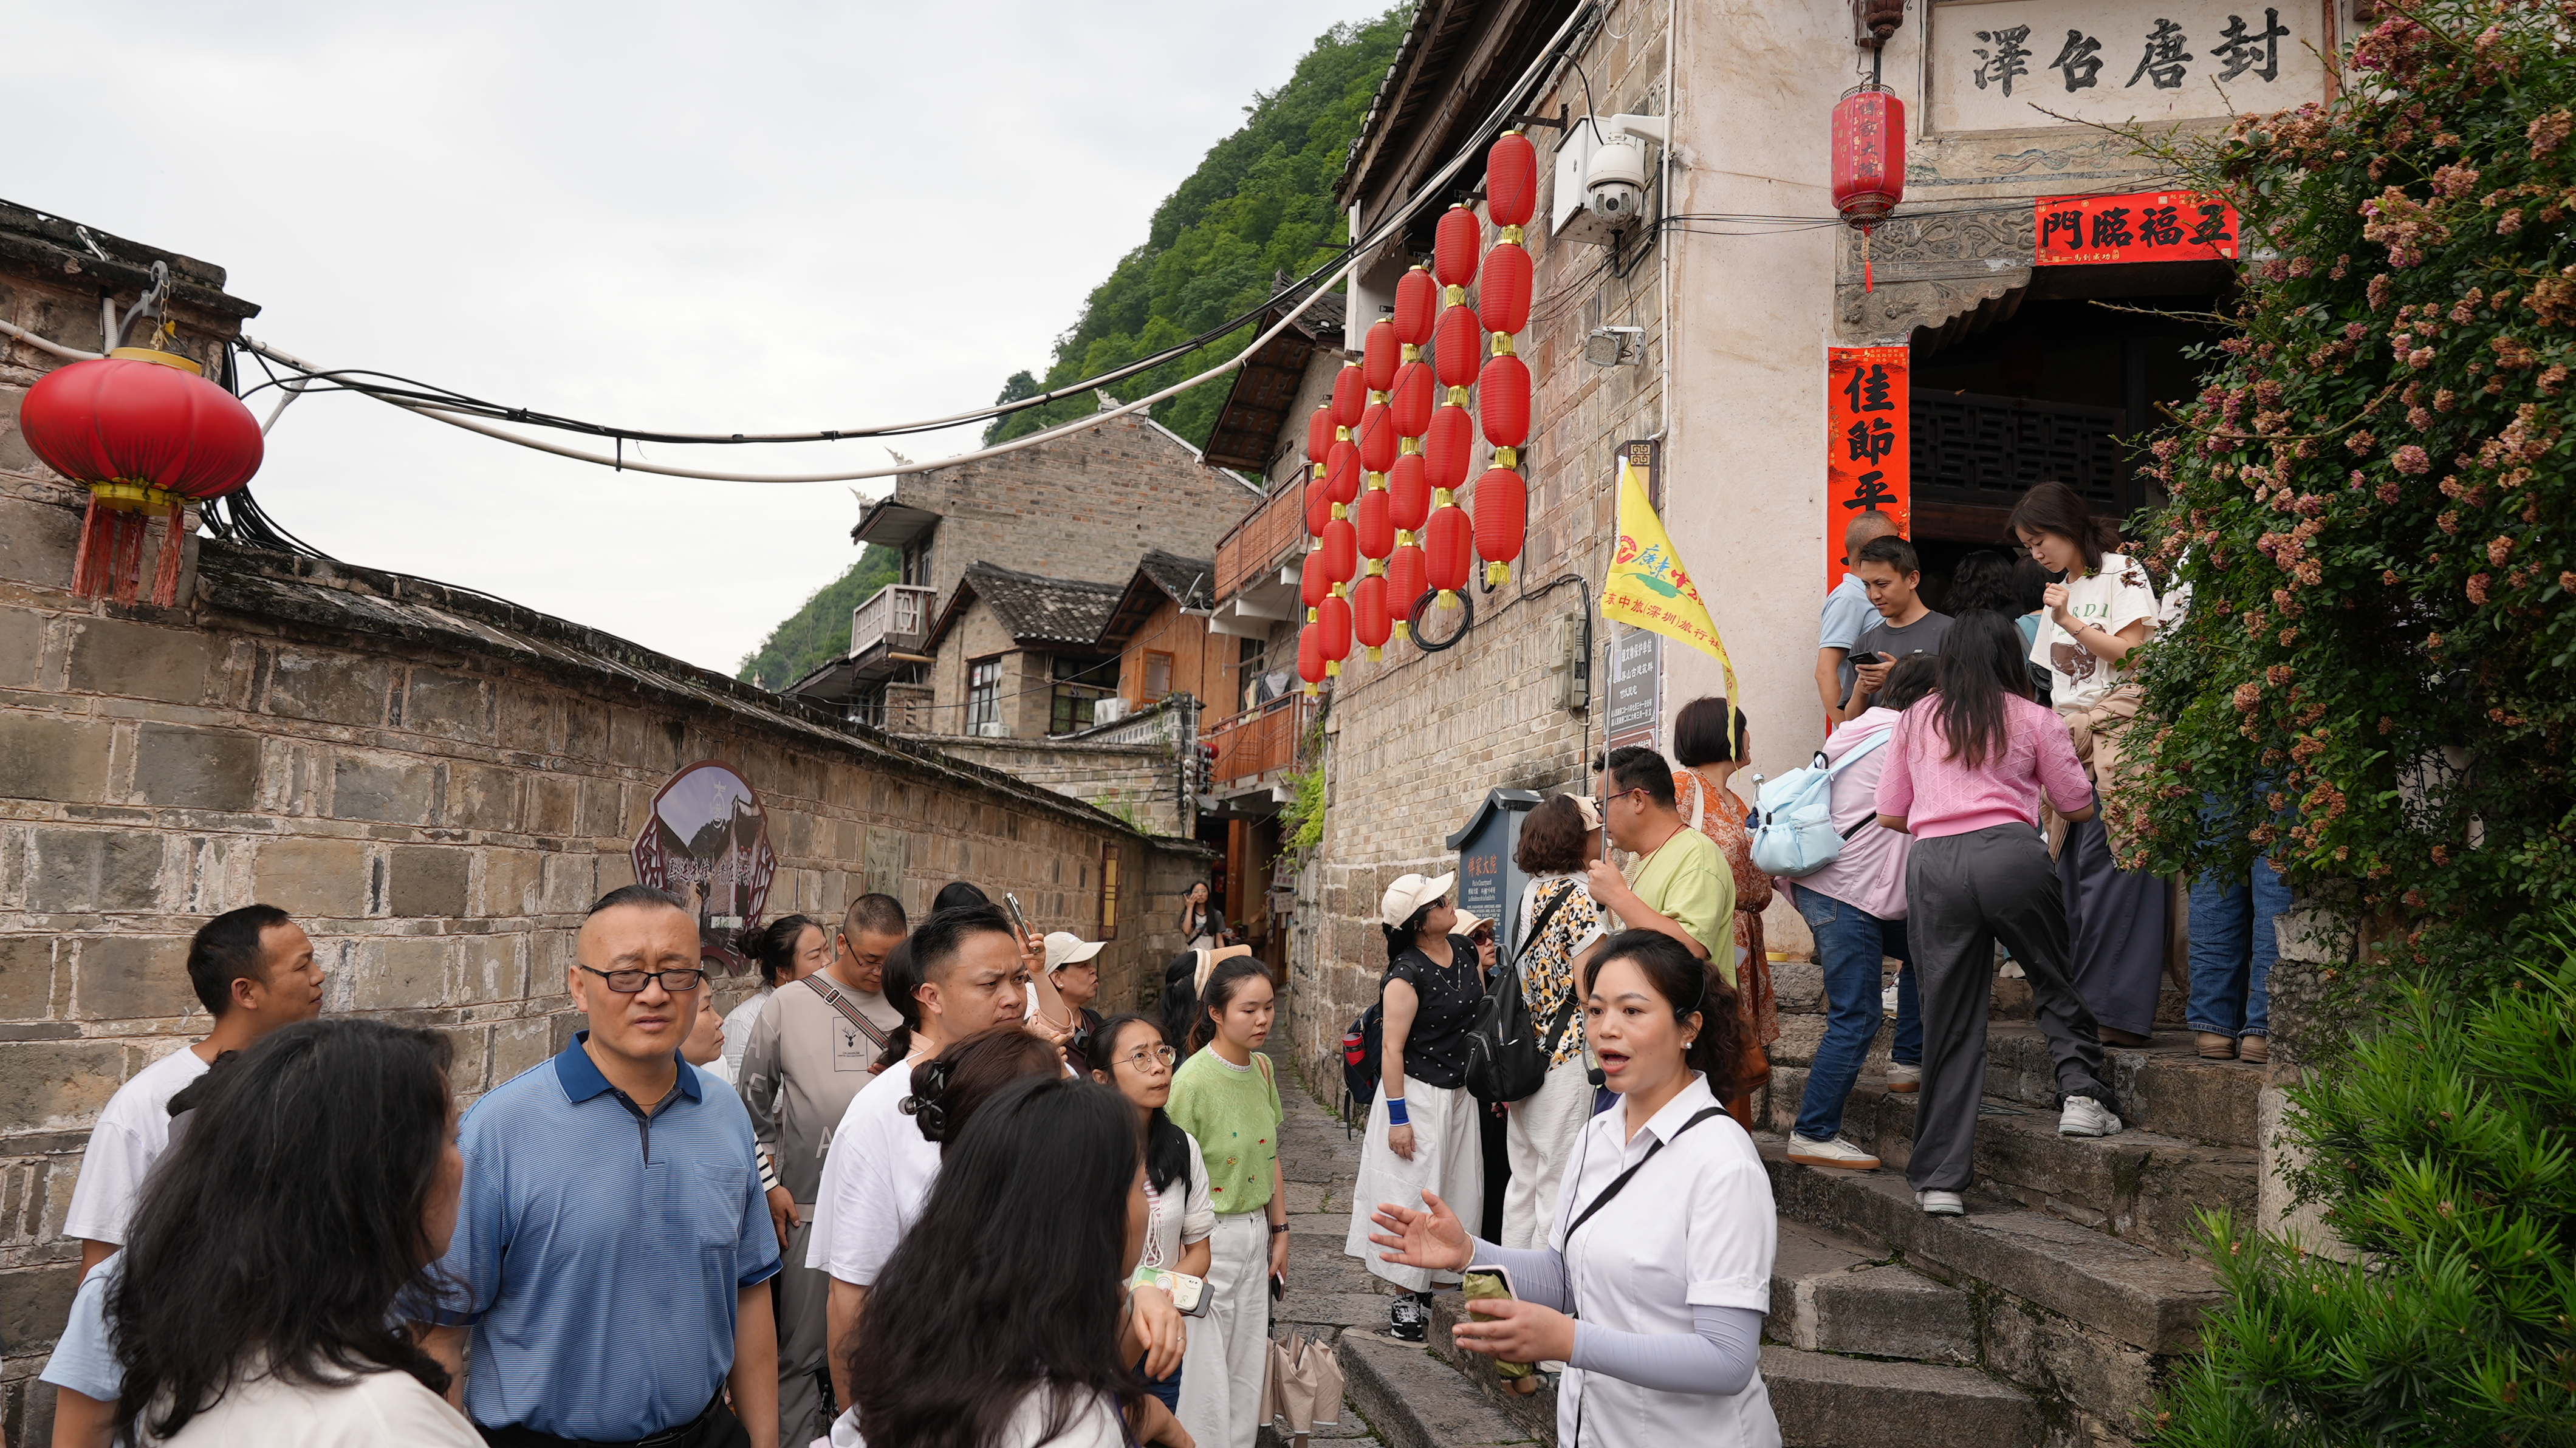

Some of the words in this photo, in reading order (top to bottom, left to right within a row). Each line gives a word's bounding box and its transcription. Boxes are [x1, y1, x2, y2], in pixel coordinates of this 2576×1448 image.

[2042, 203, 2232, 250] 五福臨門
[1840, 363, 1898, 566] 佳節平
[1603, 592, 1728, 660] 东中旅(深圳)旅行社
